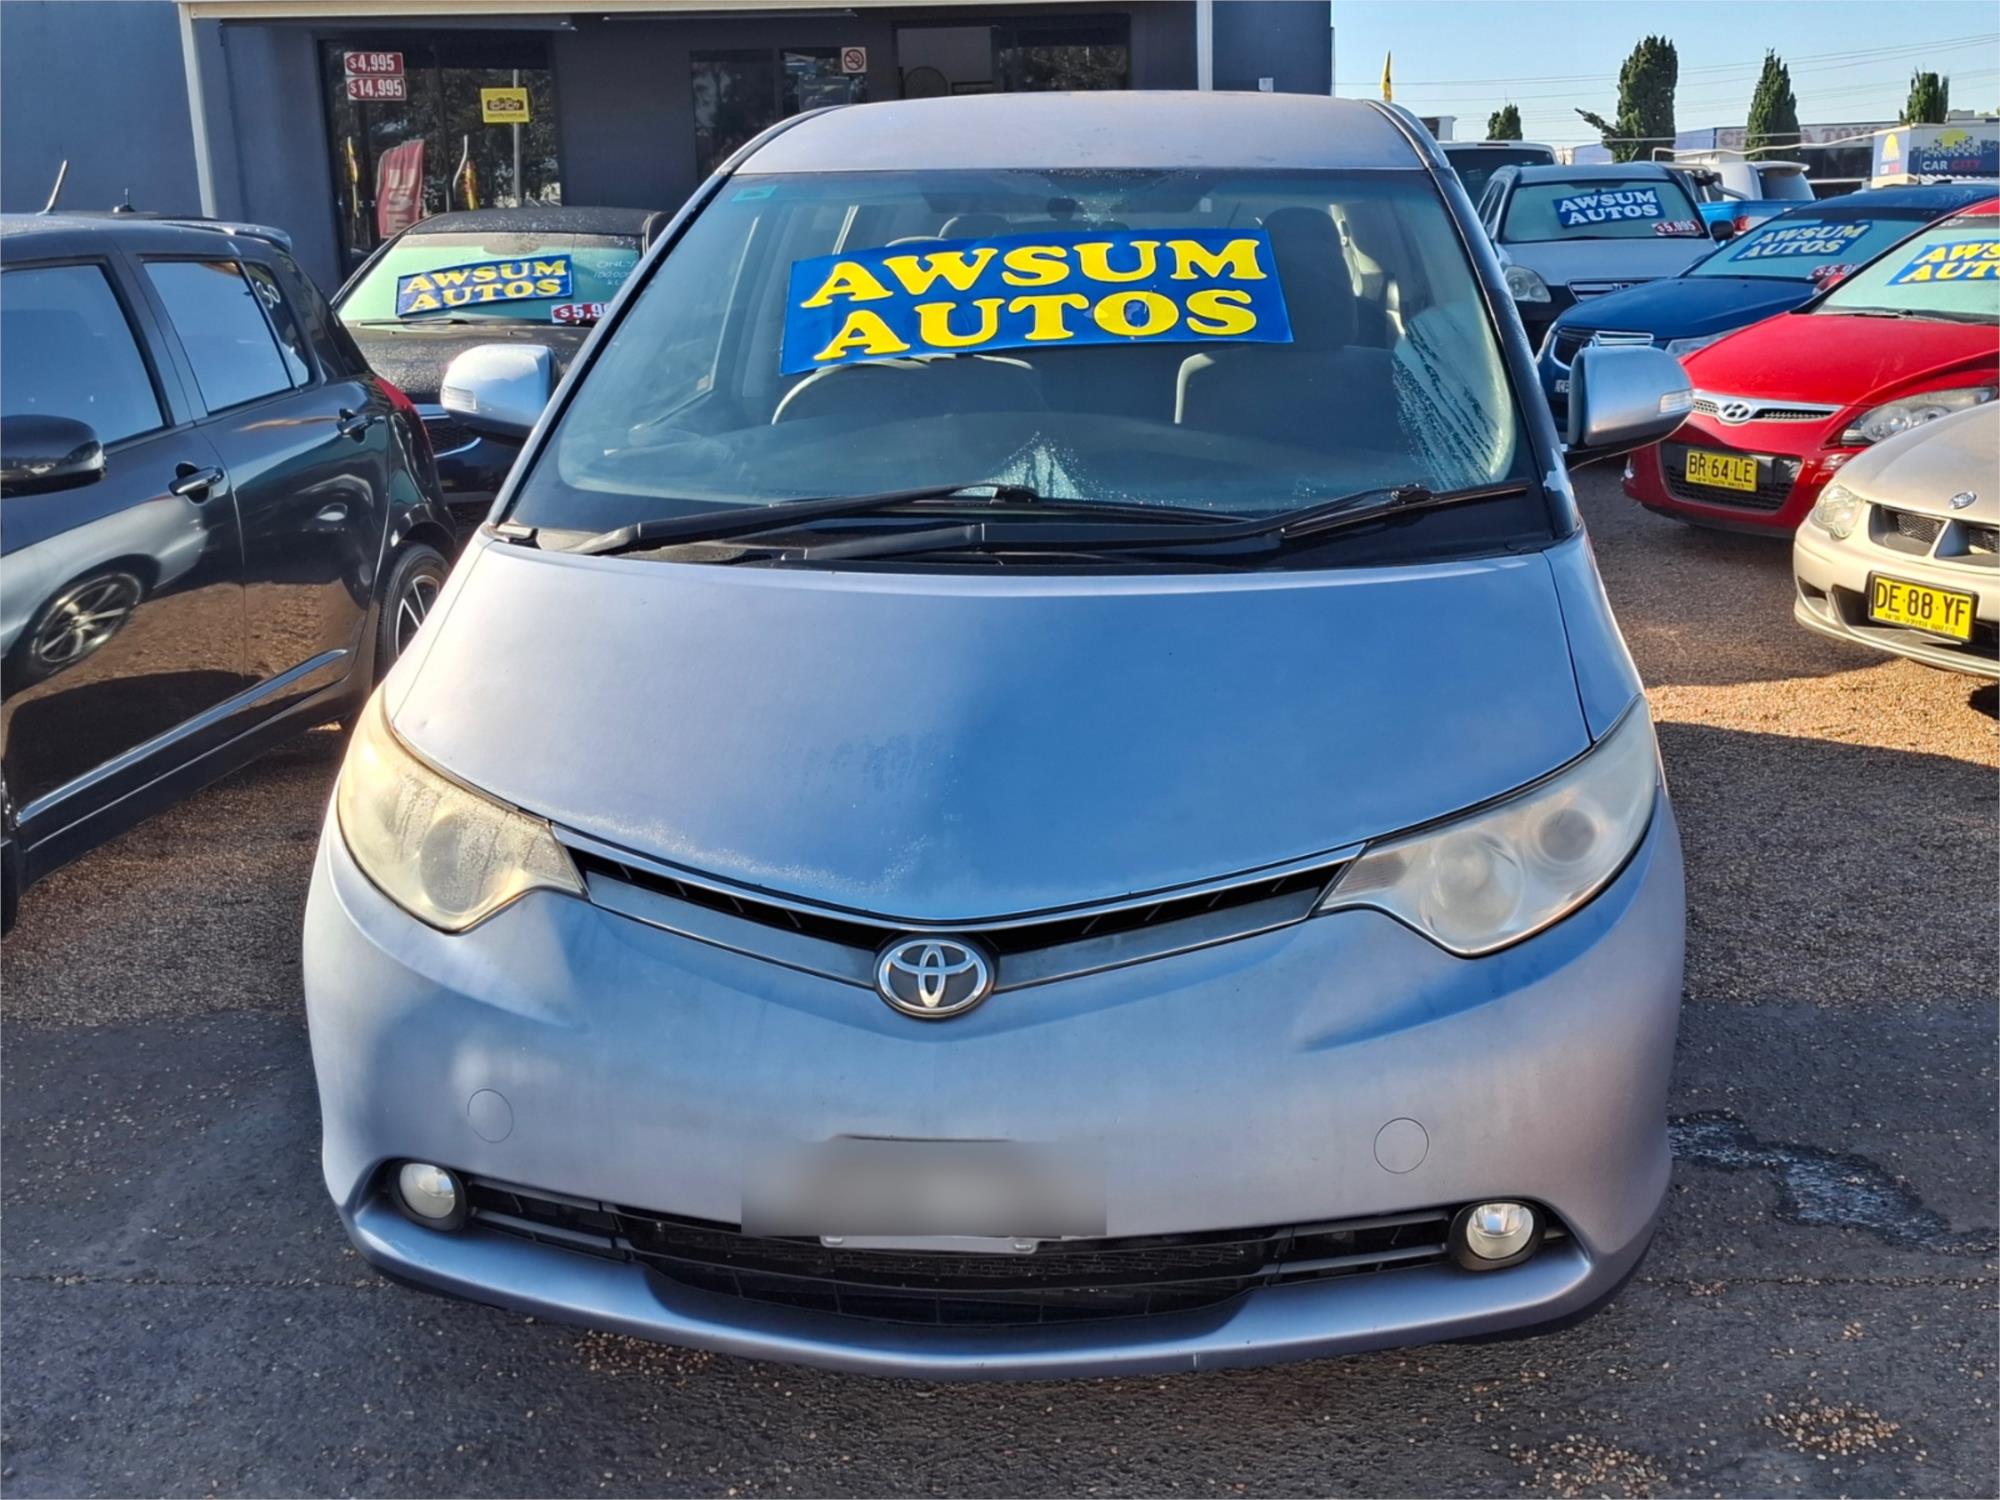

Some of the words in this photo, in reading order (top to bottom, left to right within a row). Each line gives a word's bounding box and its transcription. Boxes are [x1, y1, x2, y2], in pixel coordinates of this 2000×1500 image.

[350, 54, 395, 72] $4,995
[350, 79, 402, 97] $14,995
[1922, 160, 1948, 171] CAR
[1559, 190, 1658, 212] AWSUM
[1568, 204, 1659, 225] AUTOS
[1752, 224, 1869, 245] AWSUM
[1736, 239, 1845, 259] AUTOS
[401, 260, 567, 294] AWSUM
[800, 238, 1268, 309] AWSUM
[1898, 260, 1999, 283] AUT
[406, 279, 562, 313] AUTOS
[560, 303, 609, 319] $5,9
[812, 288, 1258, 361] AUTOS
